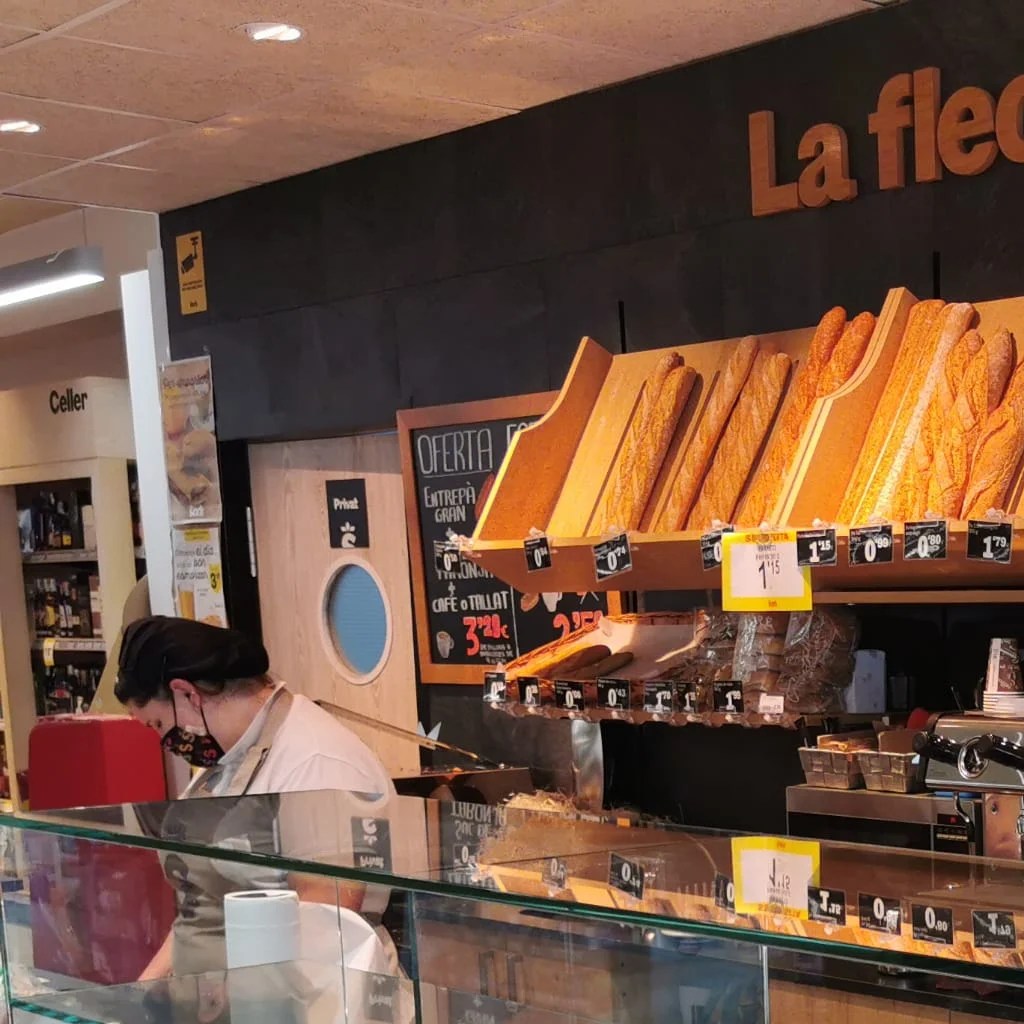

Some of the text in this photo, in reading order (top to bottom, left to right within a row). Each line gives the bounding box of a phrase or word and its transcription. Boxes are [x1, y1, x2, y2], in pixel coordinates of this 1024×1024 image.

[748, 110, 857, 217] La
[50, 388, 88, 415] Celler
[417, 428, 493, 475] OFERTA
[333, 497, 359, 511] Privat
[435, 505, 466, 523] GRAN
